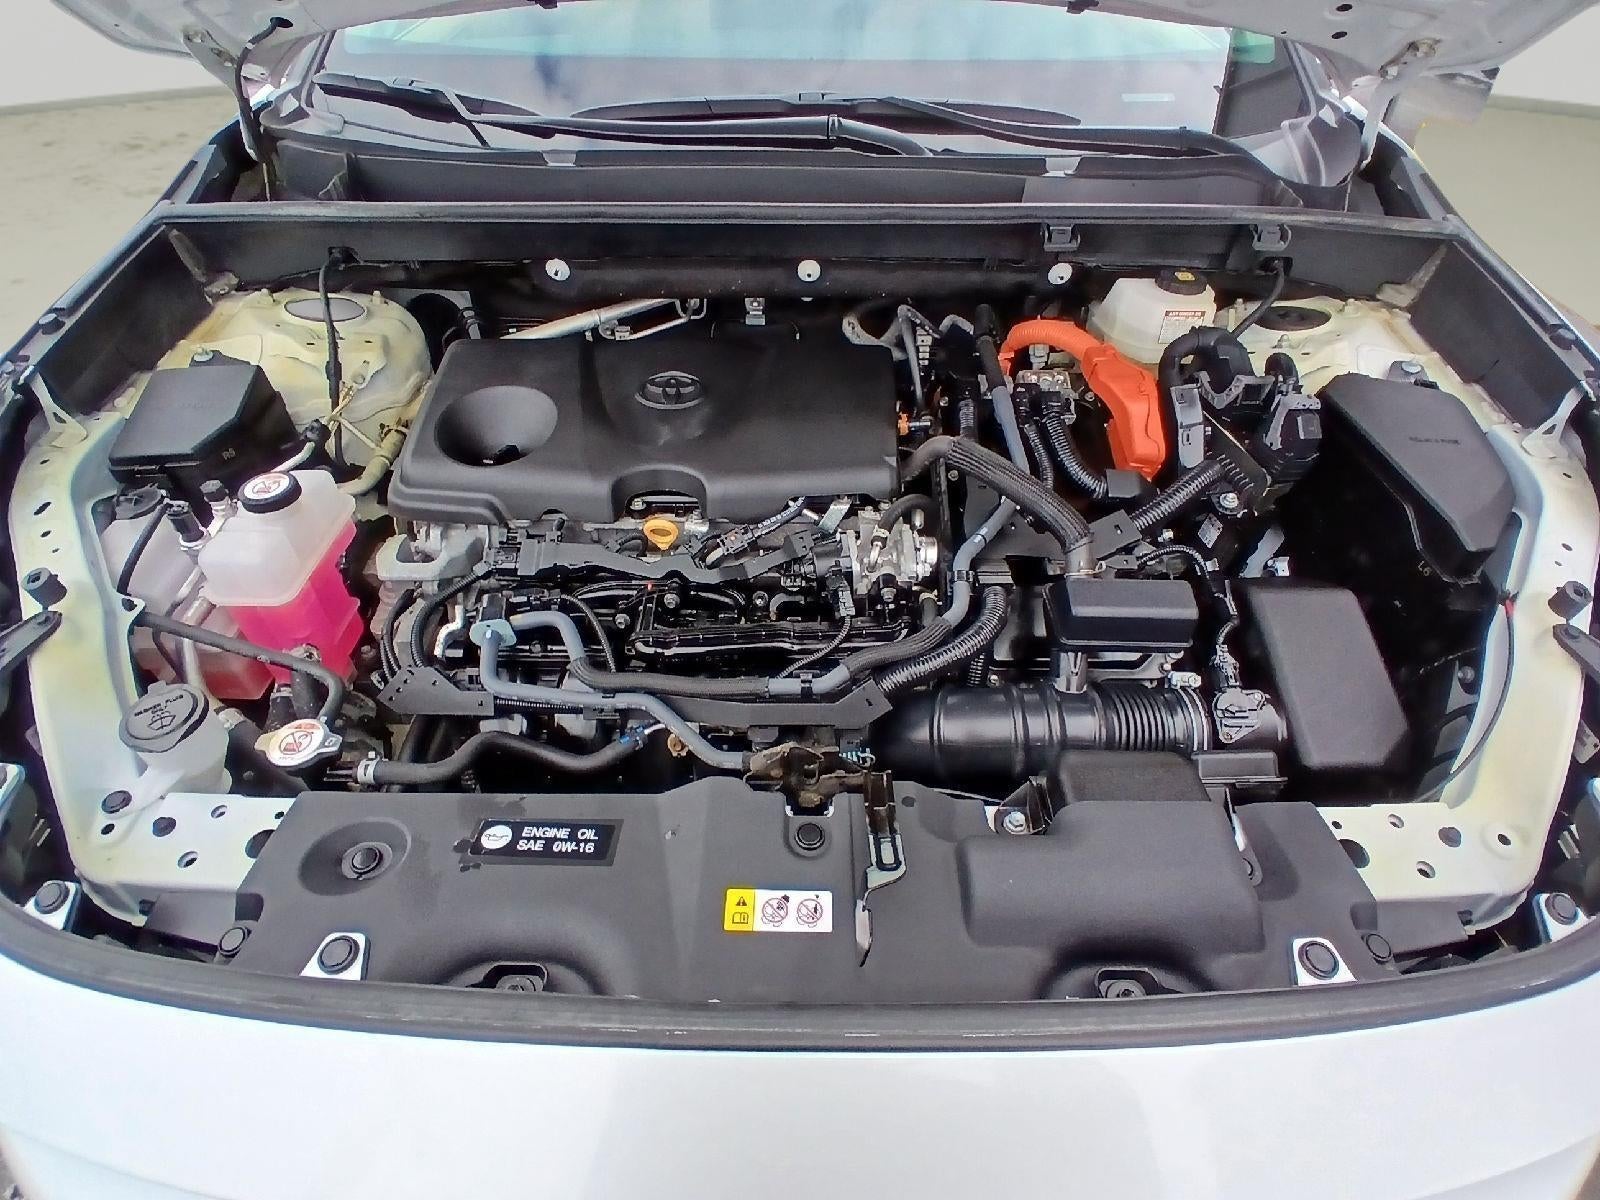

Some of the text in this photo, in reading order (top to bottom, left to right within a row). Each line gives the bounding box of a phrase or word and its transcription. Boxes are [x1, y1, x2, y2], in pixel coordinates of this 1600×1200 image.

[522, 826, 598, 840] ENGINE OIL
[516, 840, 595, 853] SAE 0W-16
